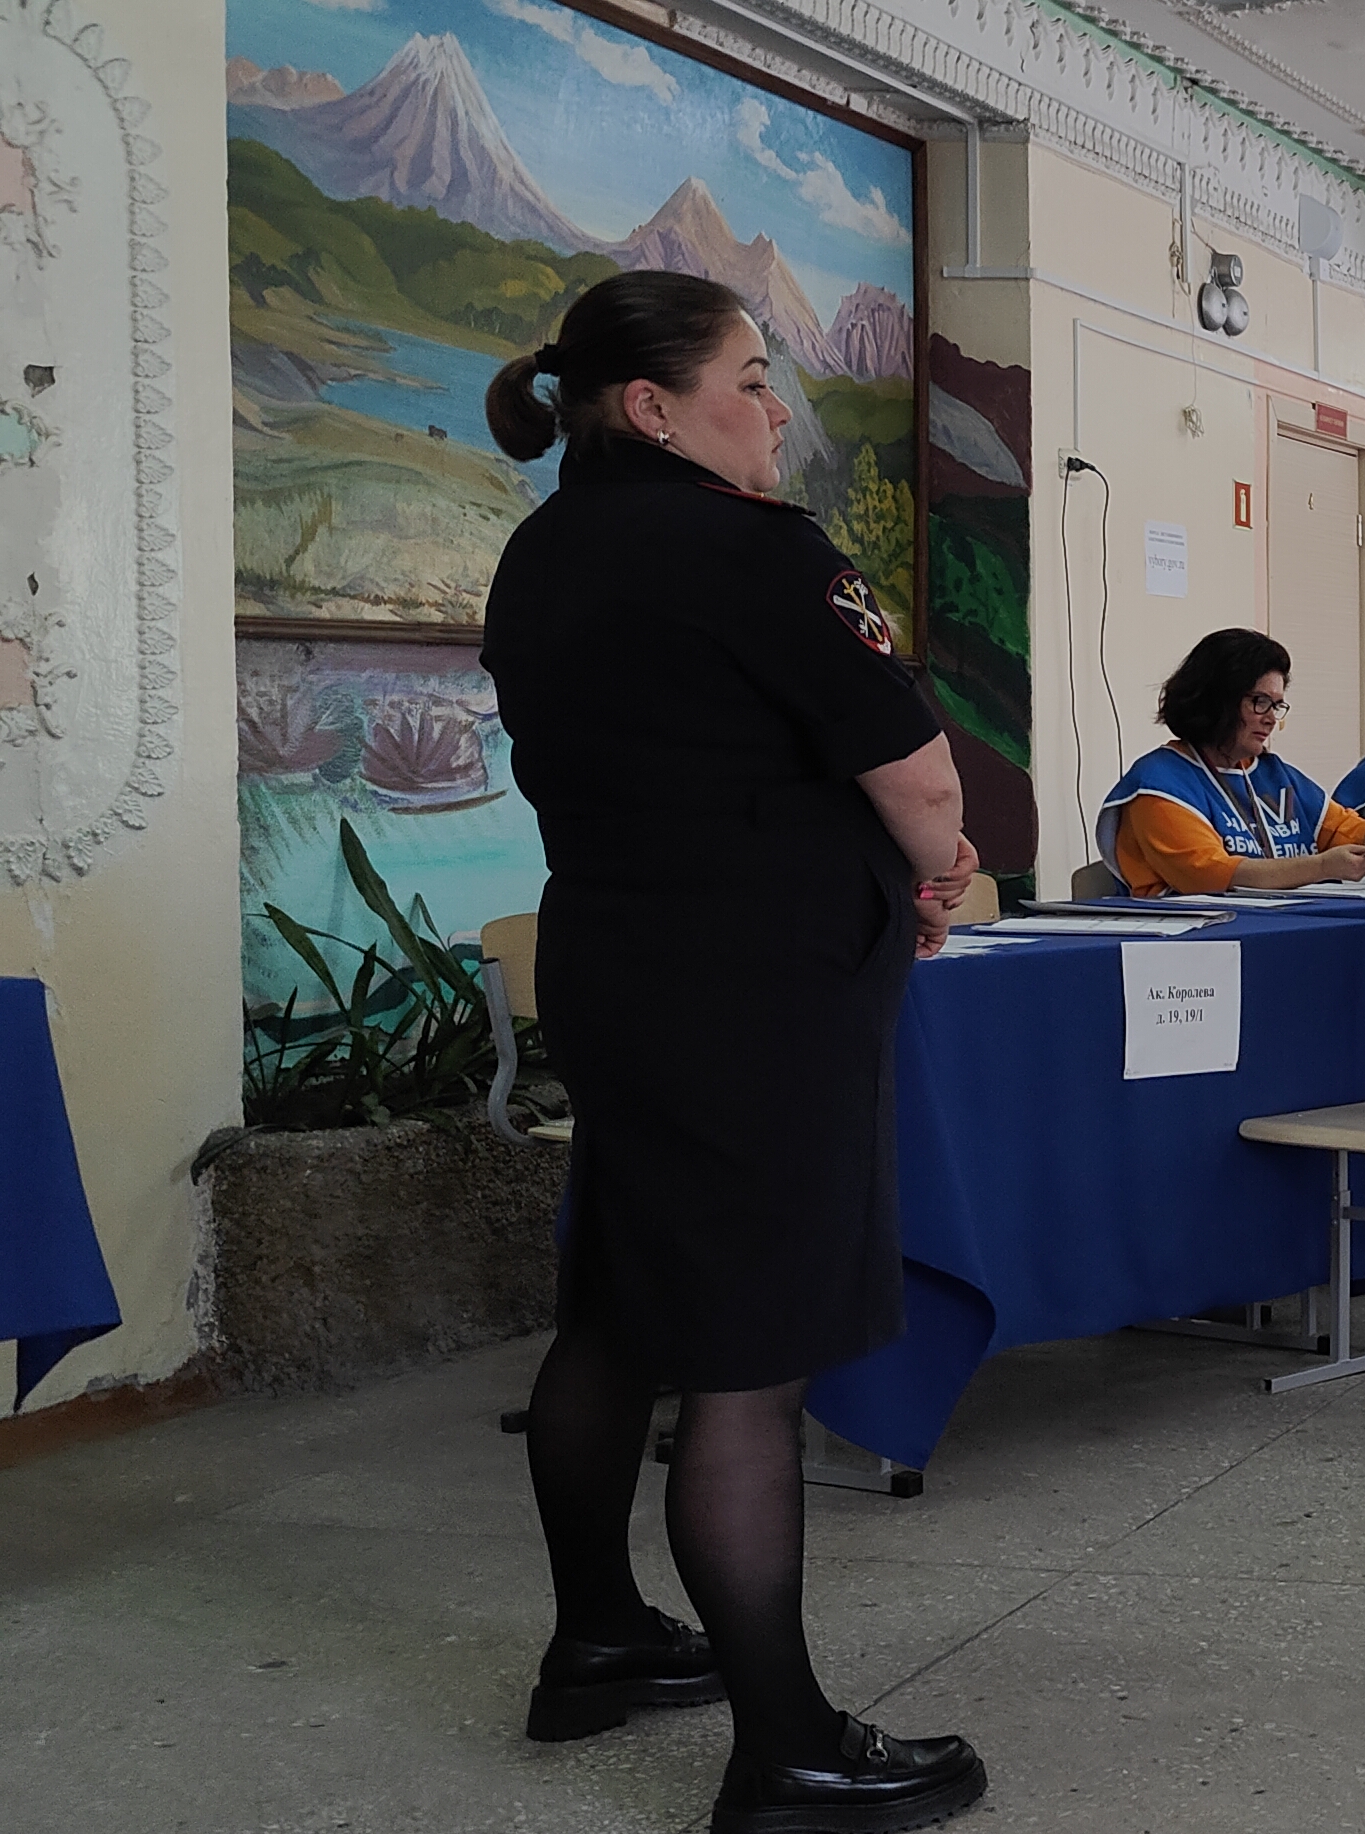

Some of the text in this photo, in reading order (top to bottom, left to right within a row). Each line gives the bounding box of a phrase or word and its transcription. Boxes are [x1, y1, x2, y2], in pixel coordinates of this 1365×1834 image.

[1147, 985, 1215, 1002] Ак. Королева
[1156, 1009, 1203, 1025] д. 19, 19/1
